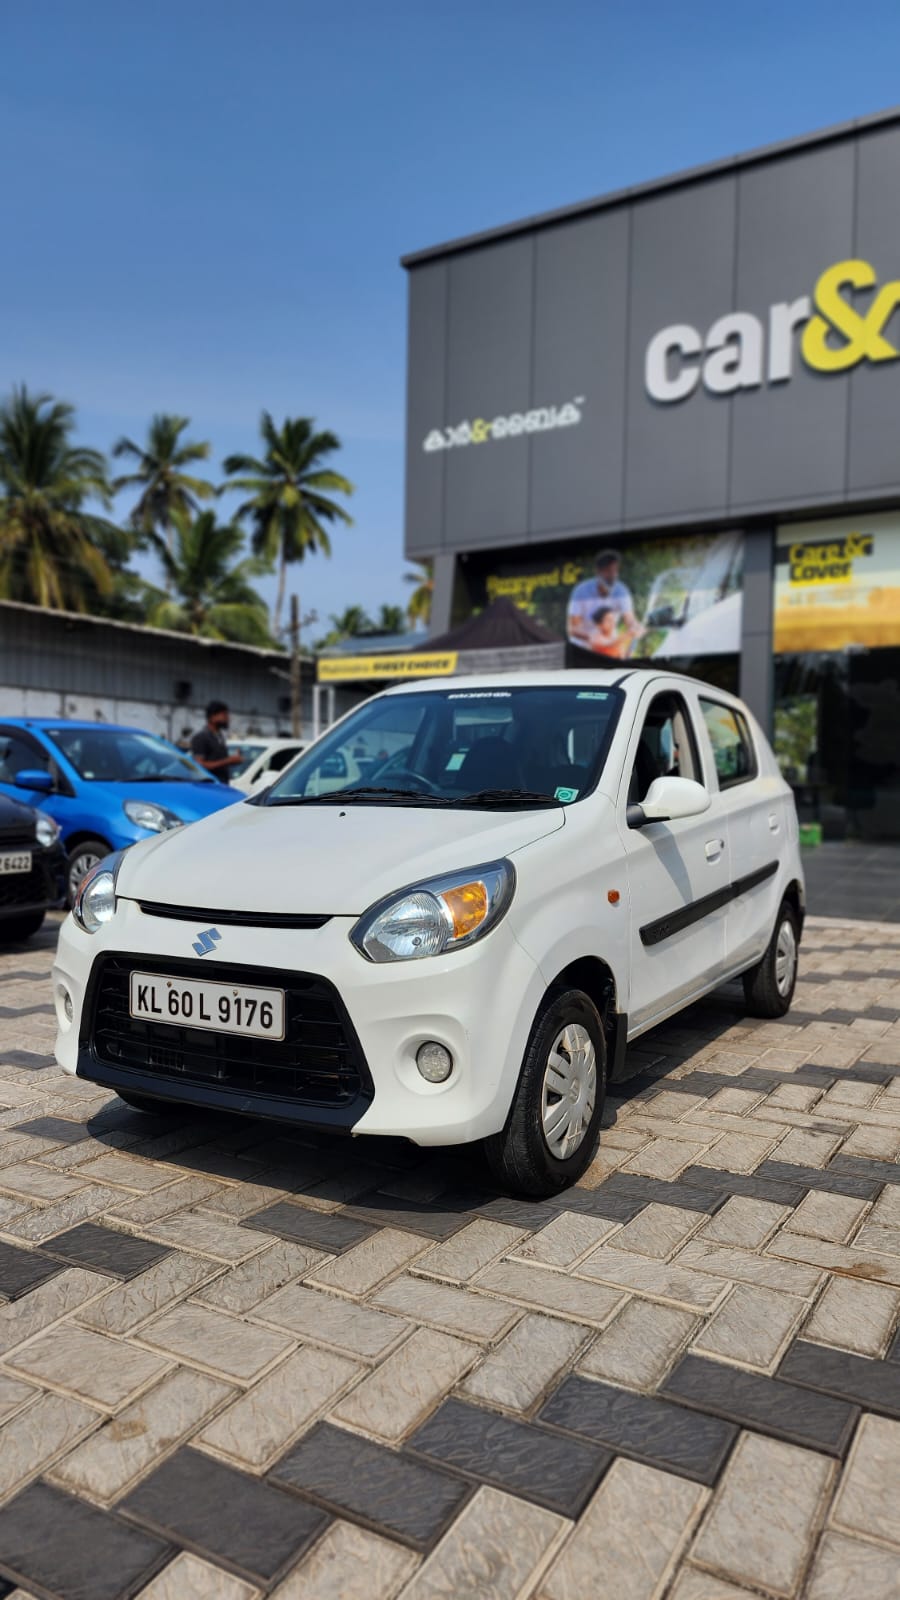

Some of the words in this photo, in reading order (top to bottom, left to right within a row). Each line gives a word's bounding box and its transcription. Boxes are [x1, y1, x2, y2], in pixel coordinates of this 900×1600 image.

[788, 543, 843, 566] Care
[844, 531, 874, 562] &
[788, 562, 850, 582] Cover
[372, 660, 405, 673] FIRST
[406, 658, 450, 671] CHOICE
[4, 856, 30, 871] 6422
[138, 984, 162, 1014] KL
[168, 989, 193, 1018] 60
[199, 992, 211, 1021] L
[218, 996, 273, 1029] 9176
